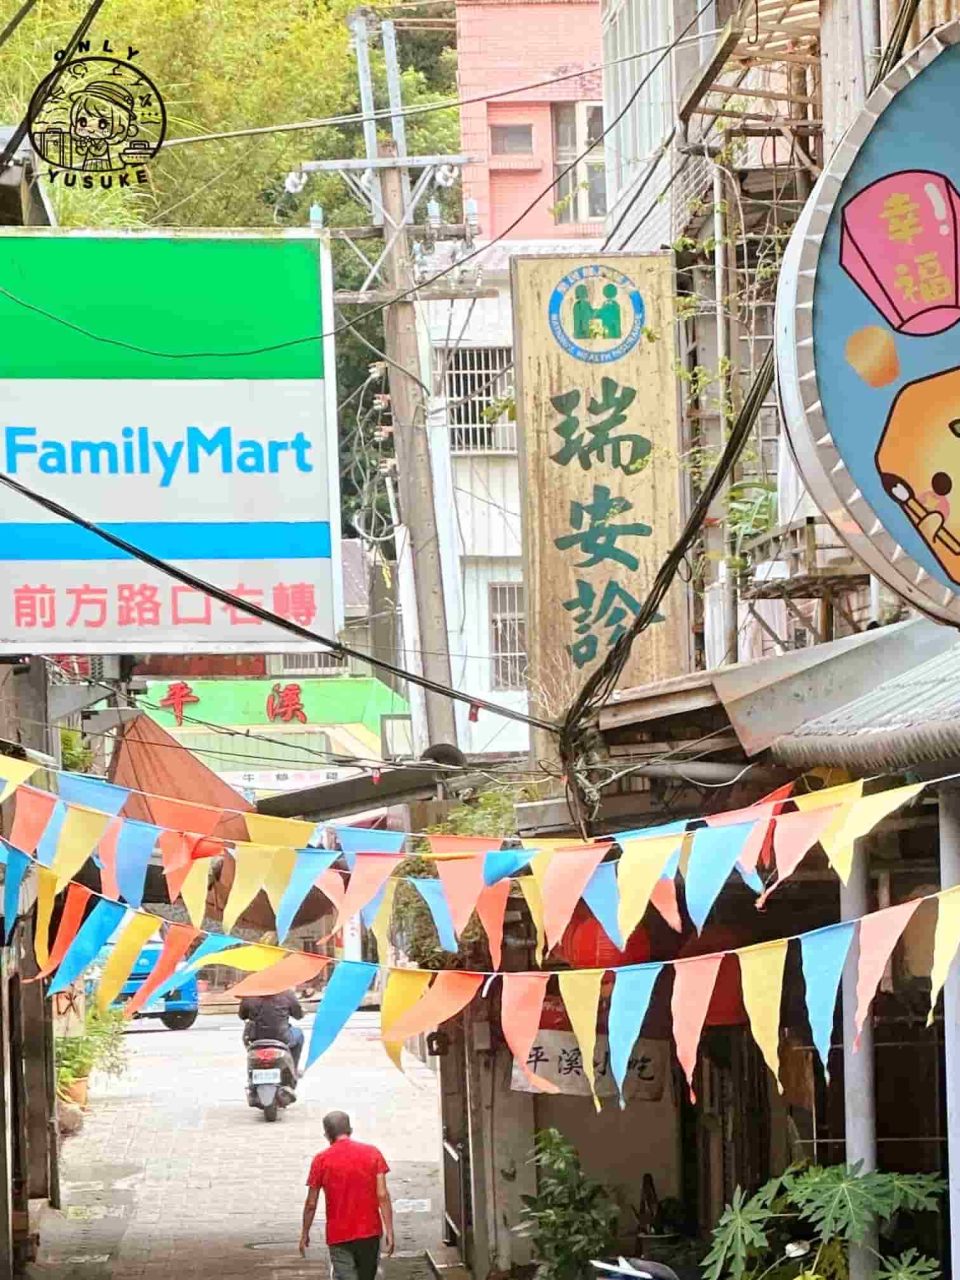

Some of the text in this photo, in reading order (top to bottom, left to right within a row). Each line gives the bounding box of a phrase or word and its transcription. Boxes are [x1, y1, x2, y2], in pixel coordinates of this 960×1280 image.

[878, 192, 953, 304] 幸福
[5, 426, 314, 487] FamilyMart
[160, 681, 307, 727] 平溪
